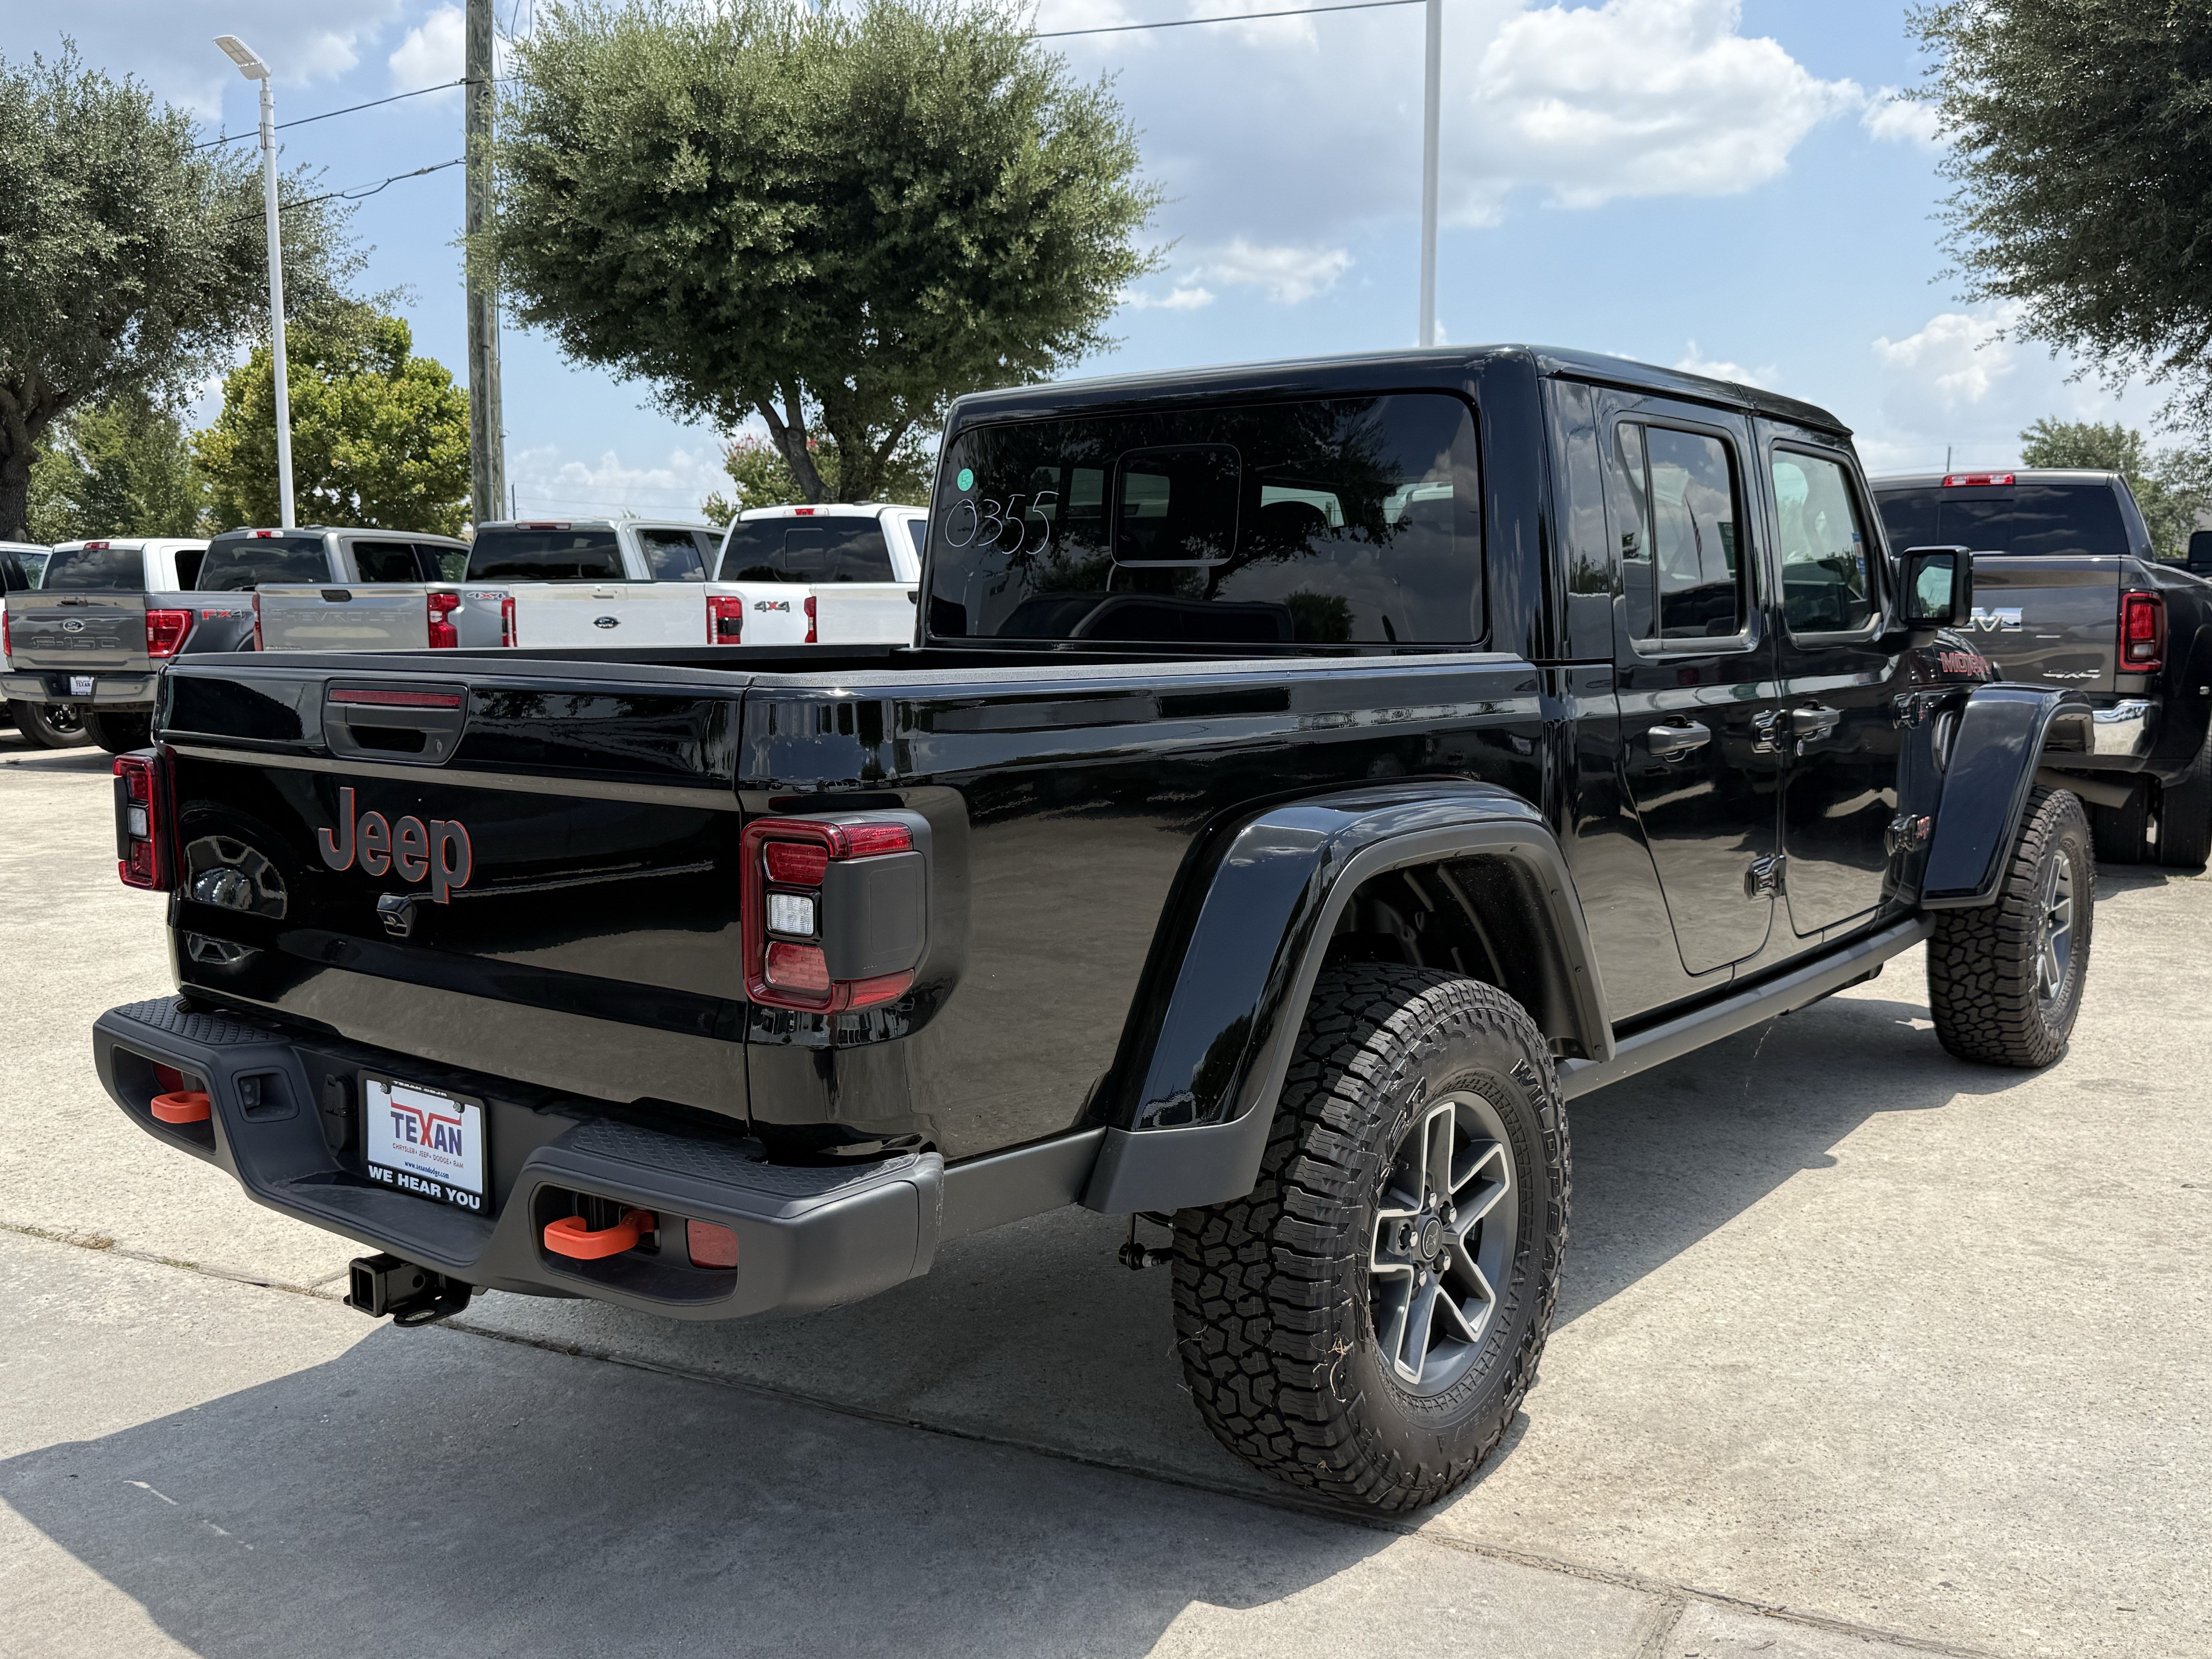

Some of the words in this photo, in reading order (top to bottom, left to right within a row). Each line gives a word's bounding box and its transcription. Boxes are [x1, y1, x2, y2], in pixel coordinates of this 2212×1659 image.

[945, 491, 1059, 555] 0355
[318, 787, 472, 904] Jeep
[393, 1080, 422, 1090] TEXAN
[391, 1097, 462, 1156] TEXAN
[393, 1143, 415, 1154] CHRYSLER
[433, 1154, 449, 1164] DODGE
[453, 1160, 464, 1169] RAM
[405, 1161, 449, 1179] www.texandodge.com
[368, 1165, 393, 1183] WE
[398, 1173, 441, 1197] HEAR
[446, 1187, 480, 1209] YOU
[1510, 1058, 1561, 1316] WILDPEAK
